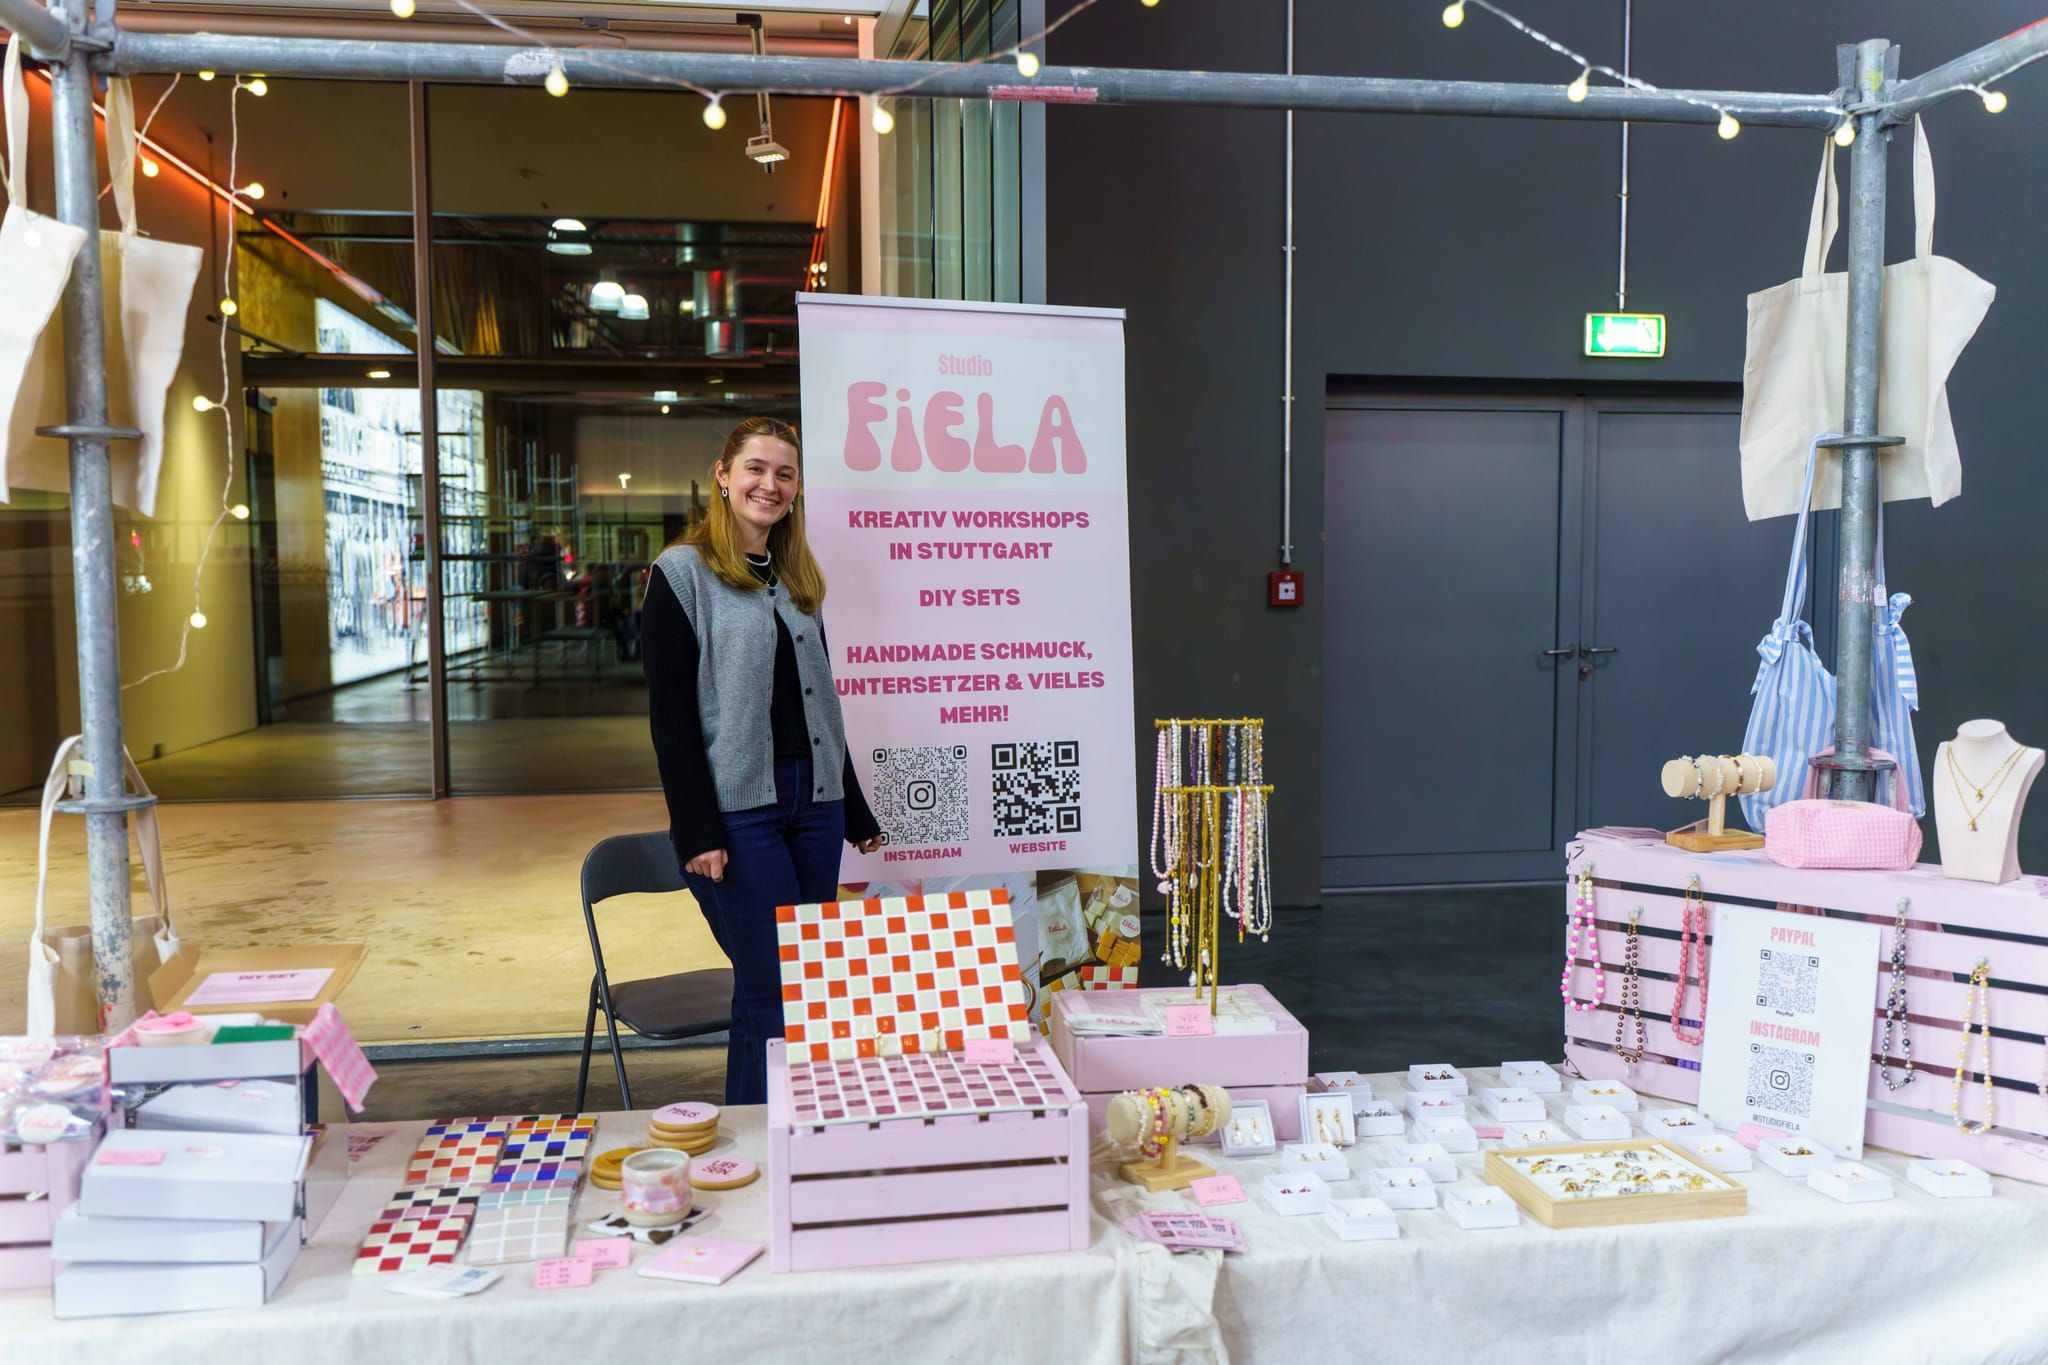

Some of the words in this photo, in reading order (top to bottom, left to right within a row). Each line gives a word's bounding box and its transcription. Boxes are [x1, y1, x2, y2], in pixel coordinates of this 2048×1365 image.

[938, 354, 993, 377] Studio
[843, 381, 1088, 474] FiELA
[848, 511, 947, 528] KREATIV
[952, 511, 1090, 529] WORKSHOPS
[889, 543, 913, 560] IN
[917, 542, 1053, 560] STUTTGART
[919, 590, 957, 607] DIY
[962, 589, 1021, 606] SETS
[846, 643, 976, 664] HANDMADE
[981, 641, 1093, 660] SCHMUCK,
[835, 674, 1000, 696] UNTERSETZER
[1005, 673, 1023, 691] &
[1028, 671, 1105, 690] VIELES
[940, 705, 1009, 724] MEHR!
[884, 847, 962, 863] INSTAGRAM
[1009, 840, 1067, 854] WEBSITE
[1770, 926, 1816, 947] PAYPAL
[1749, 1020, 1821, 1048] INSTAGRAM
[1752, 1114, 1801, 1132] @STUDIOFIELA
